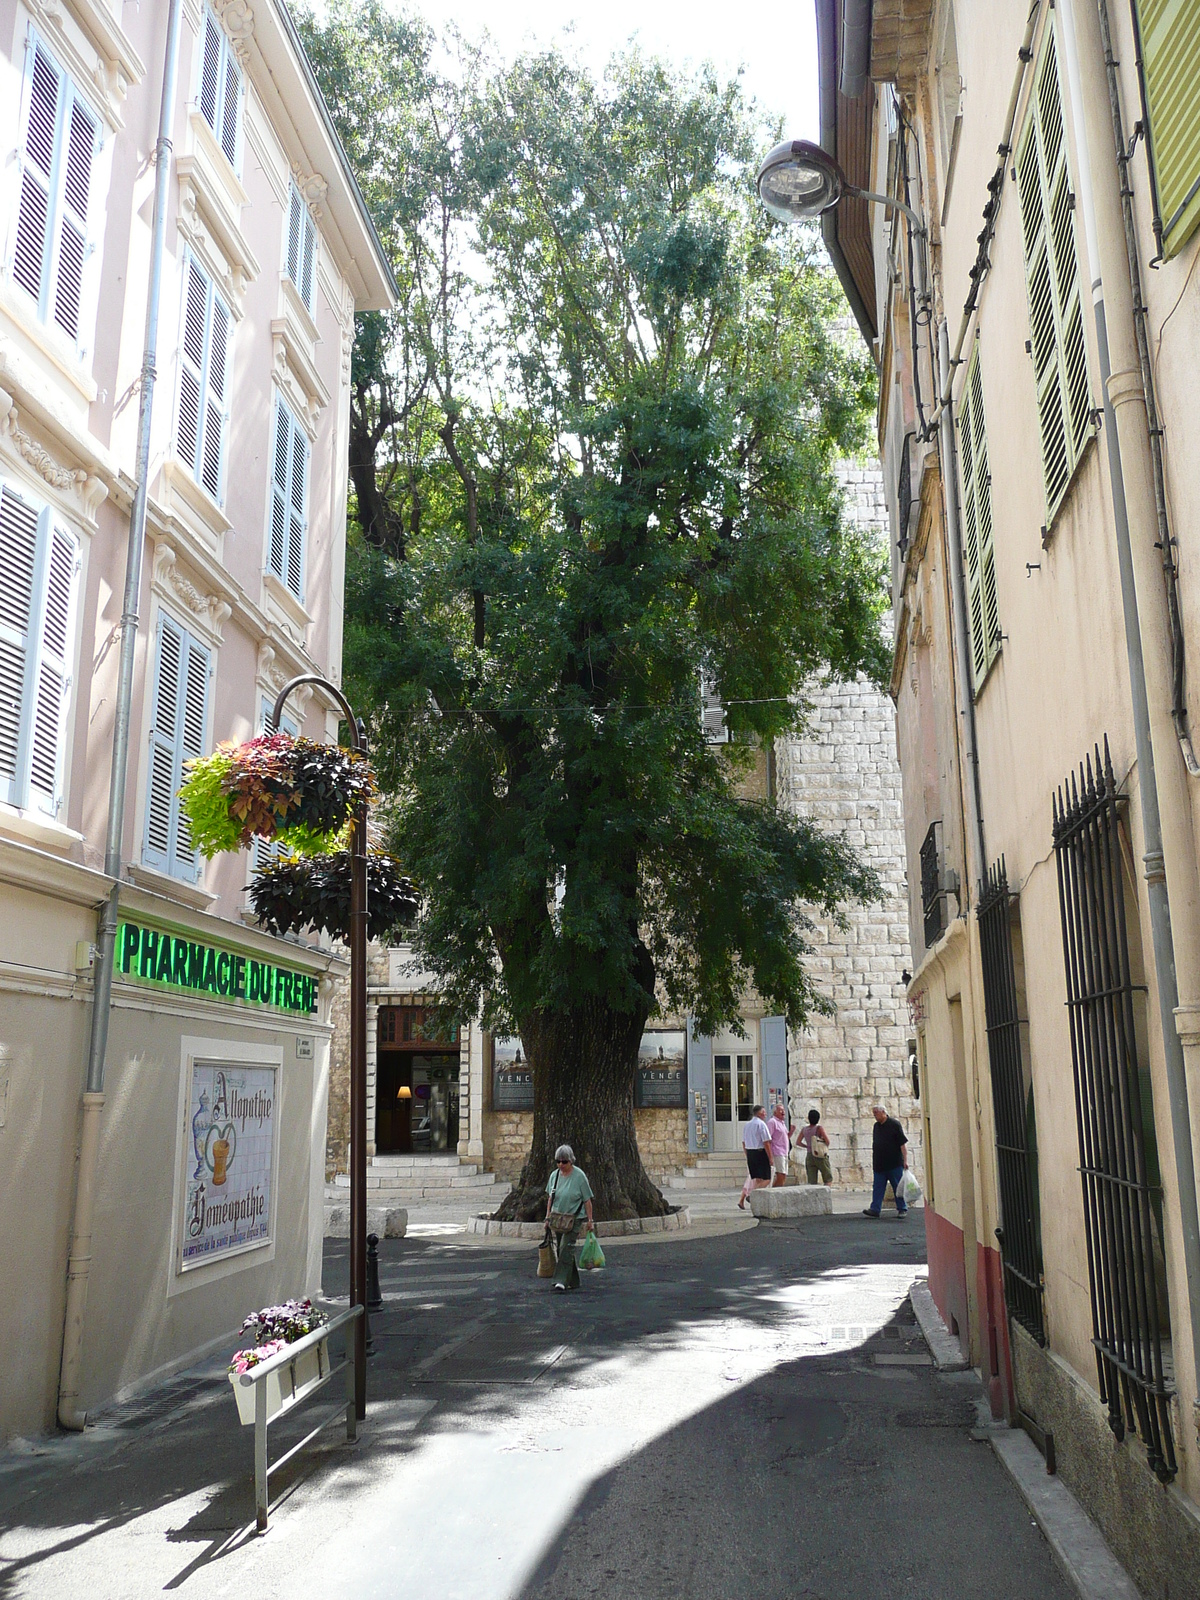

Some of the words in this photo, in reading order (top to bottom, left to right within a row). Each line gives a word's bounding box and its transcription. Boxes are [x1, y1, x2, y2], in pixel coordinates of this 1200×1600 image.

[121, 923, 246, 998] PHARMACIE
[246, 959, 271, 1003] DU
[273, 967, 319, 1013] FRENE
[213, 1071, 272, 1133] Allopathie
[642, 1072, 681, 1080] VENCE
[190, 1182, 265, 1237] Homéopathie
